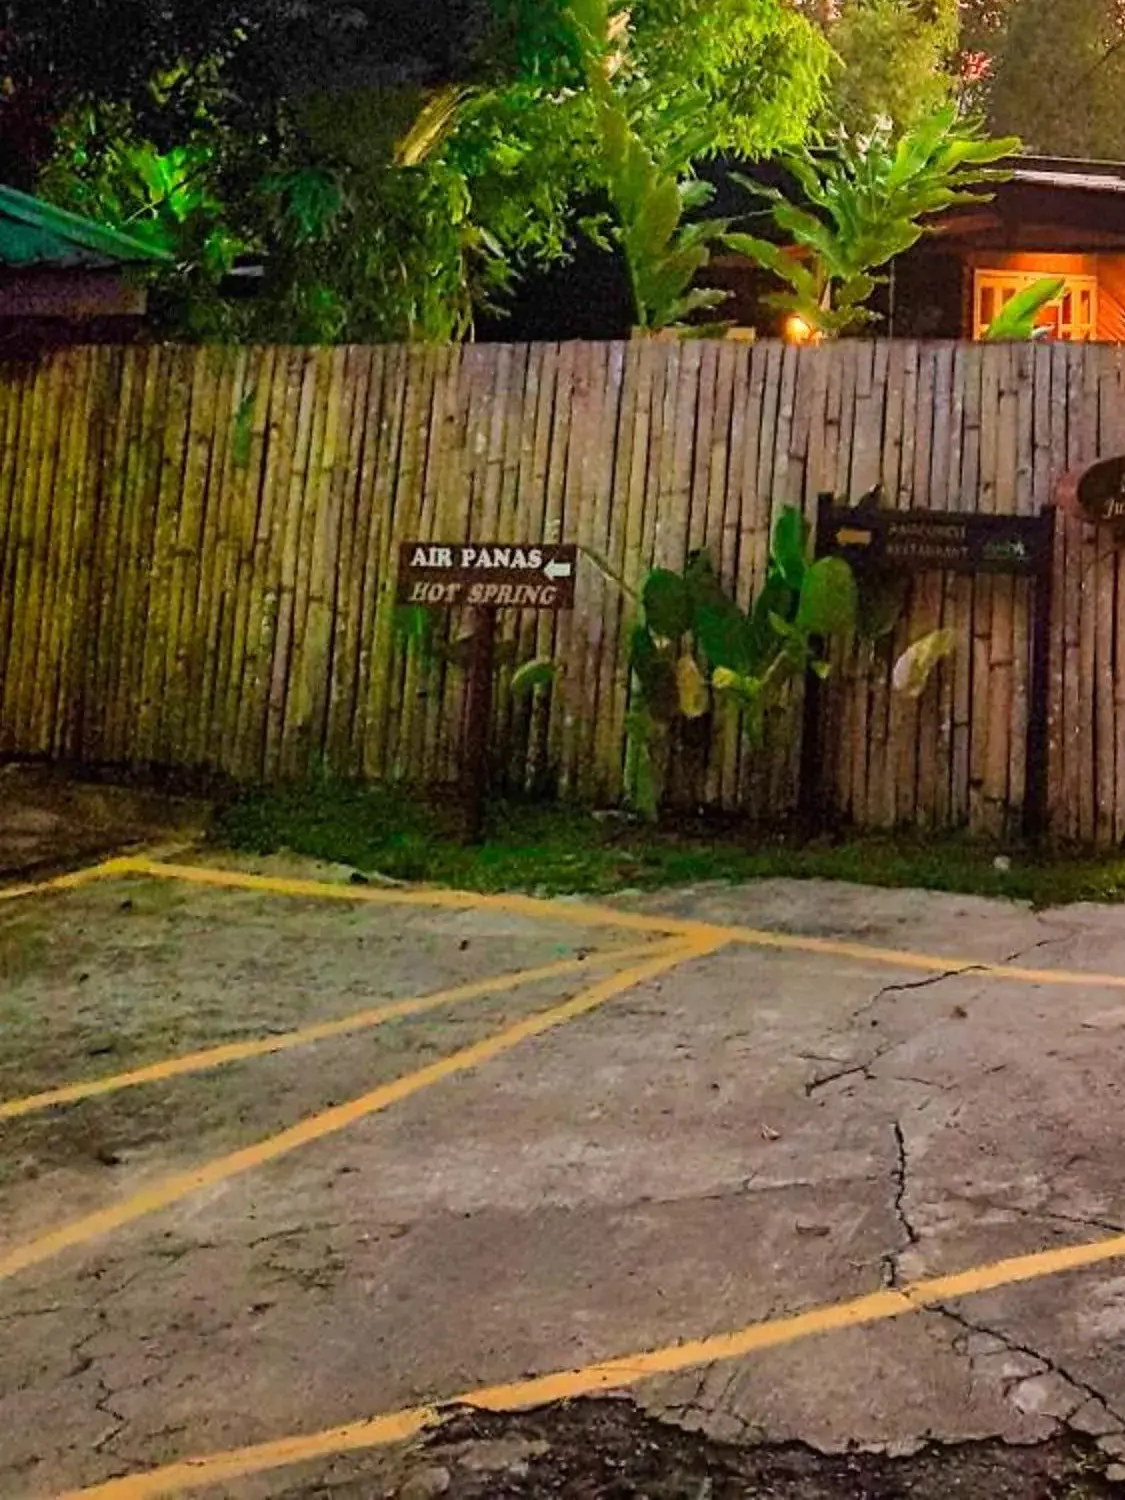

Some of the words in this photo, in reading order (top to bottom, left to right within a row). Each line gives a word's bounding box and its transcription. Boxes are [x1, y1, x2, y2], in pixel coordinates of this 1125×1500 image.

[409, 546, 453, 568] AIR
[460, 547, 543, 570] PANAS
[408, 581, 461, 604] HOT
[467, 582, 558, 605] SPRING
